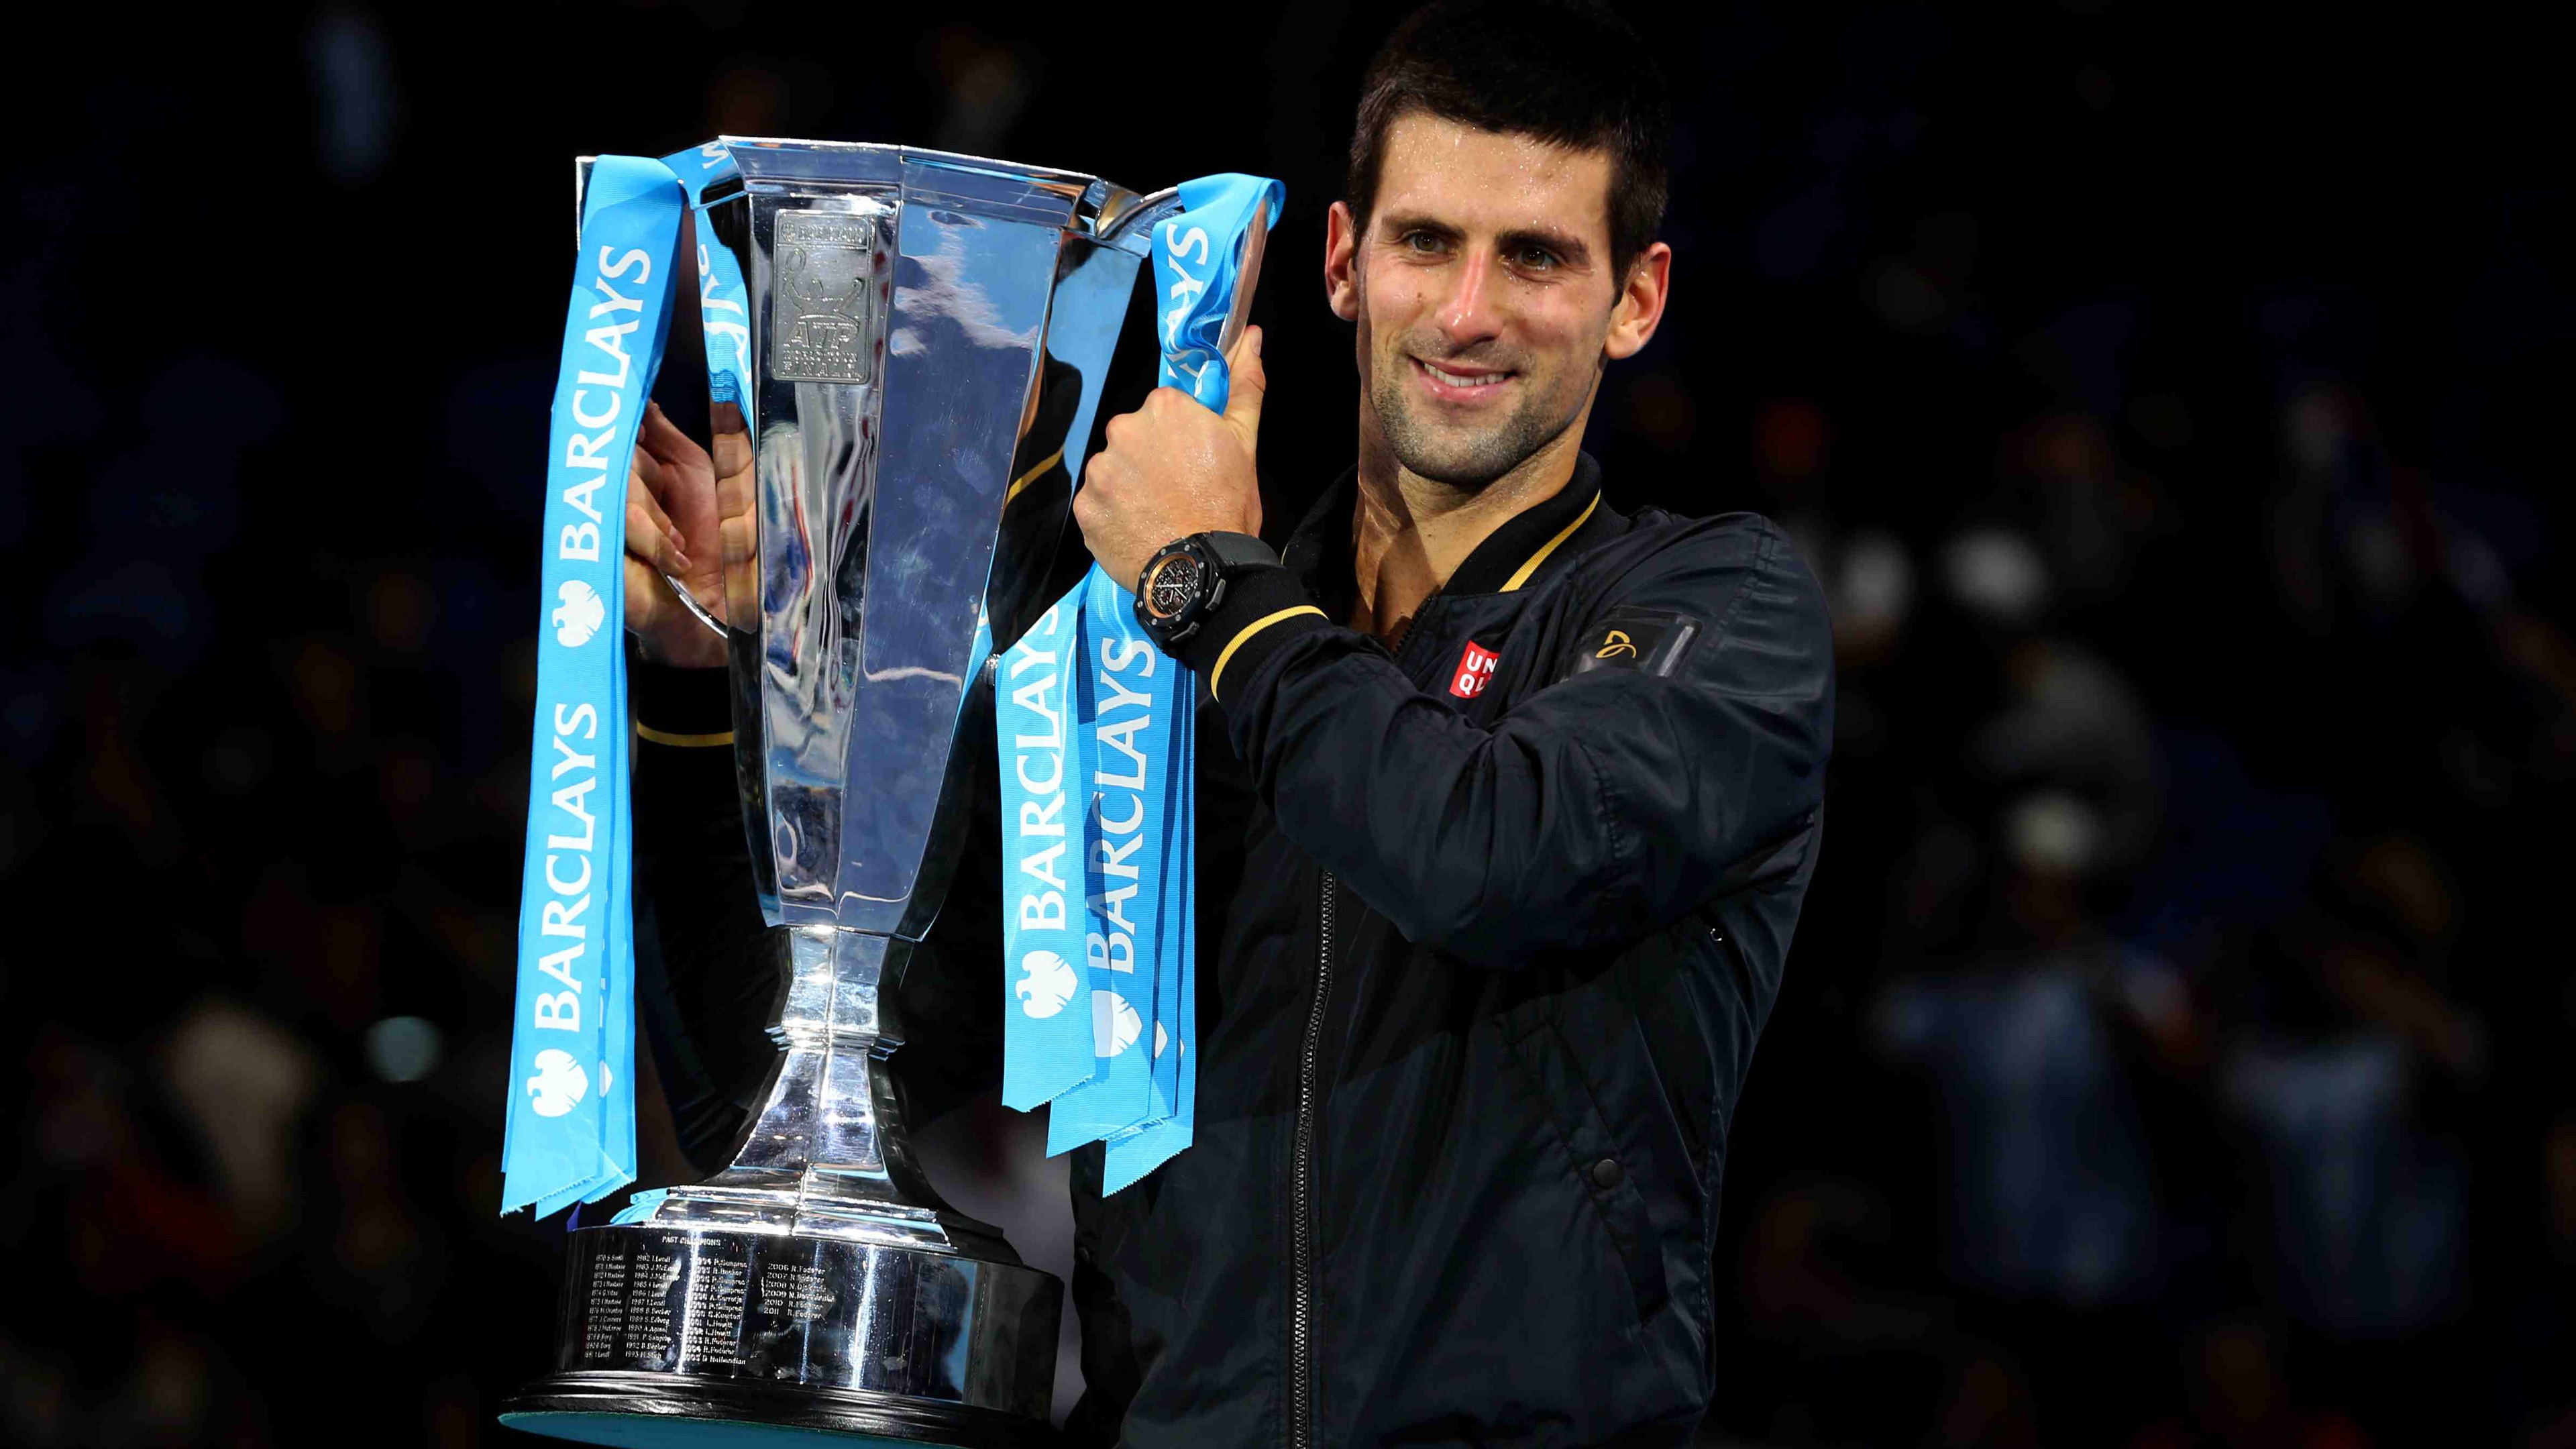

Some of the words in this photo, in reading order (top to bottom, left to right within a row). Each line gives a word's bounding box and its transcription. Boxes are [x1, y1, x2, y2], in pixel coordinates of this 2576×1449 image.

[784, 321, 859, 349] ATP
[559, 245, 650, 562] BARCLAYS
[1466, 650, 1498, 674] UN
[1459, 674, 1485, 696] QL
[1085, 637, 1156, 975] BARCLAYS
[535, 702, 598, 1032] BARCLAYS
[698, 1257, 711, 1265] 994
[765, 1289, 787, 1297] 2009
[690, 1318, 702, 1326] 001
[688, 1327, 703, 1335] 002
[688, 1336, 702, 1344] 003
[686, 1344, 701, 1353] 004
[686, 1353, 701, 1362] 005
